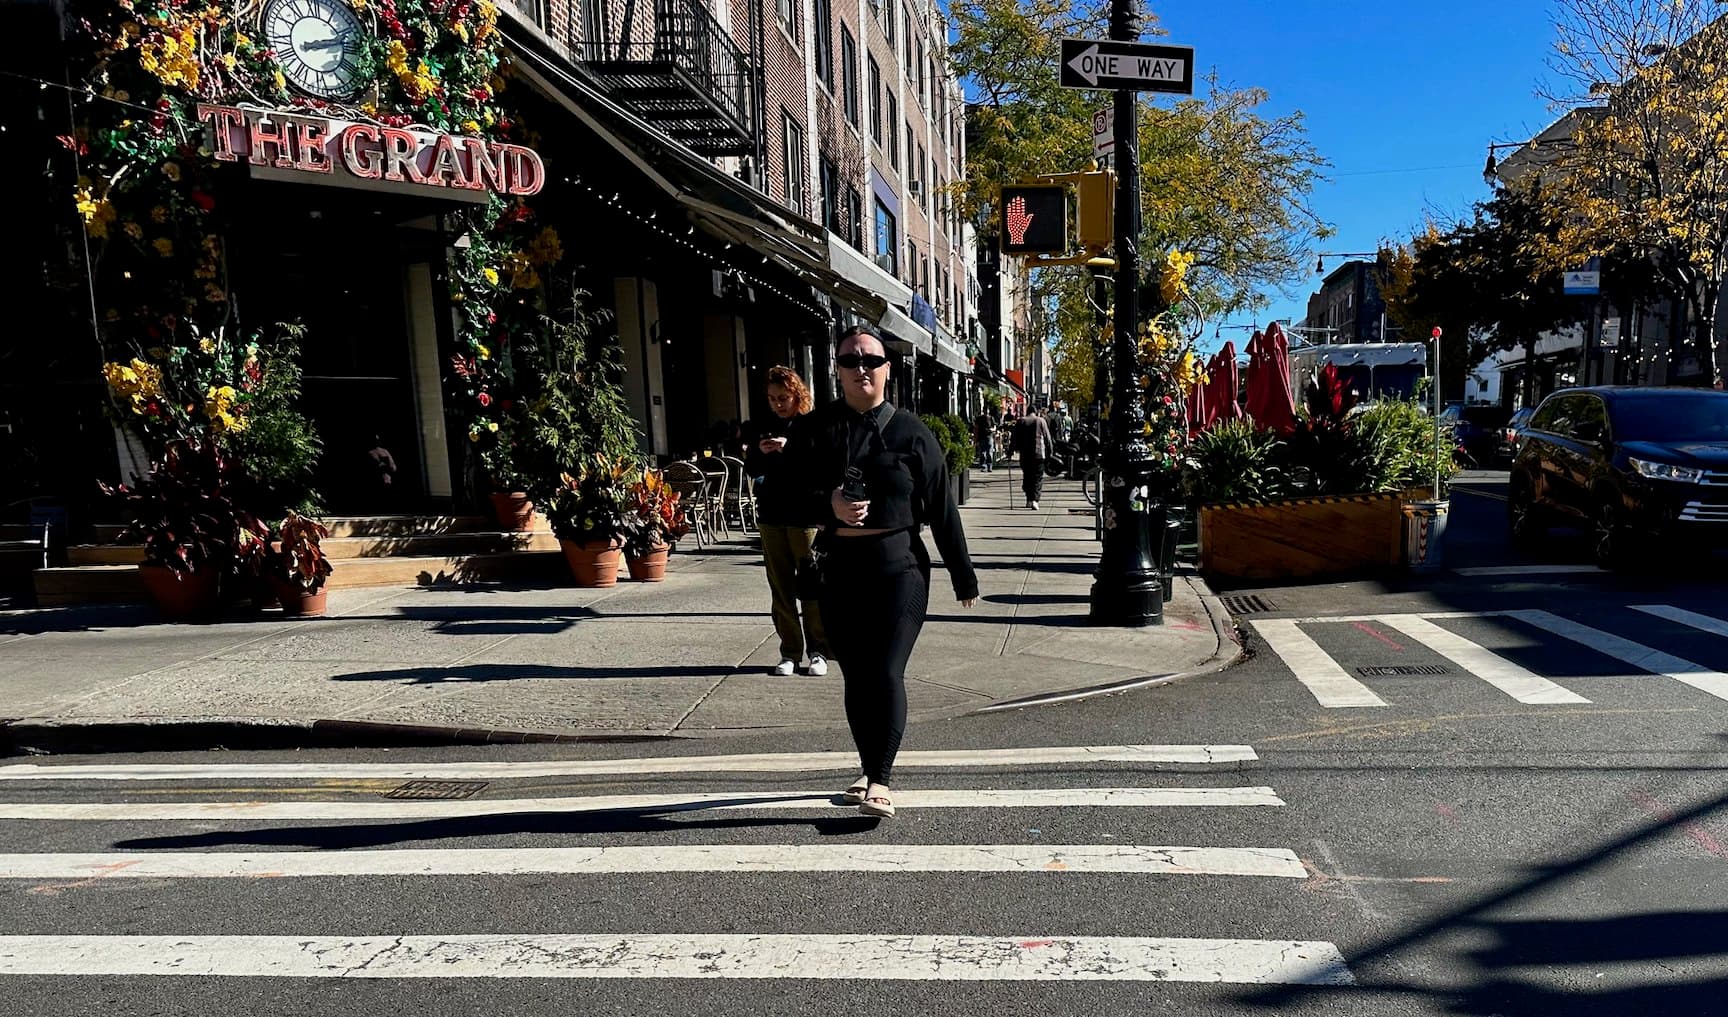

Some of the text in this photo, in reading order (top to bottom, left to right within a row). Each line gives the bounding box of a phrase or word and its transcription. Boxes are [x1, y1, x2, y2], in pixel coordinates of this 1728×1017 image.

[1081, 55, 1177, 79] ONE WAY
[197, 103, 546, 196] THE GRAND
